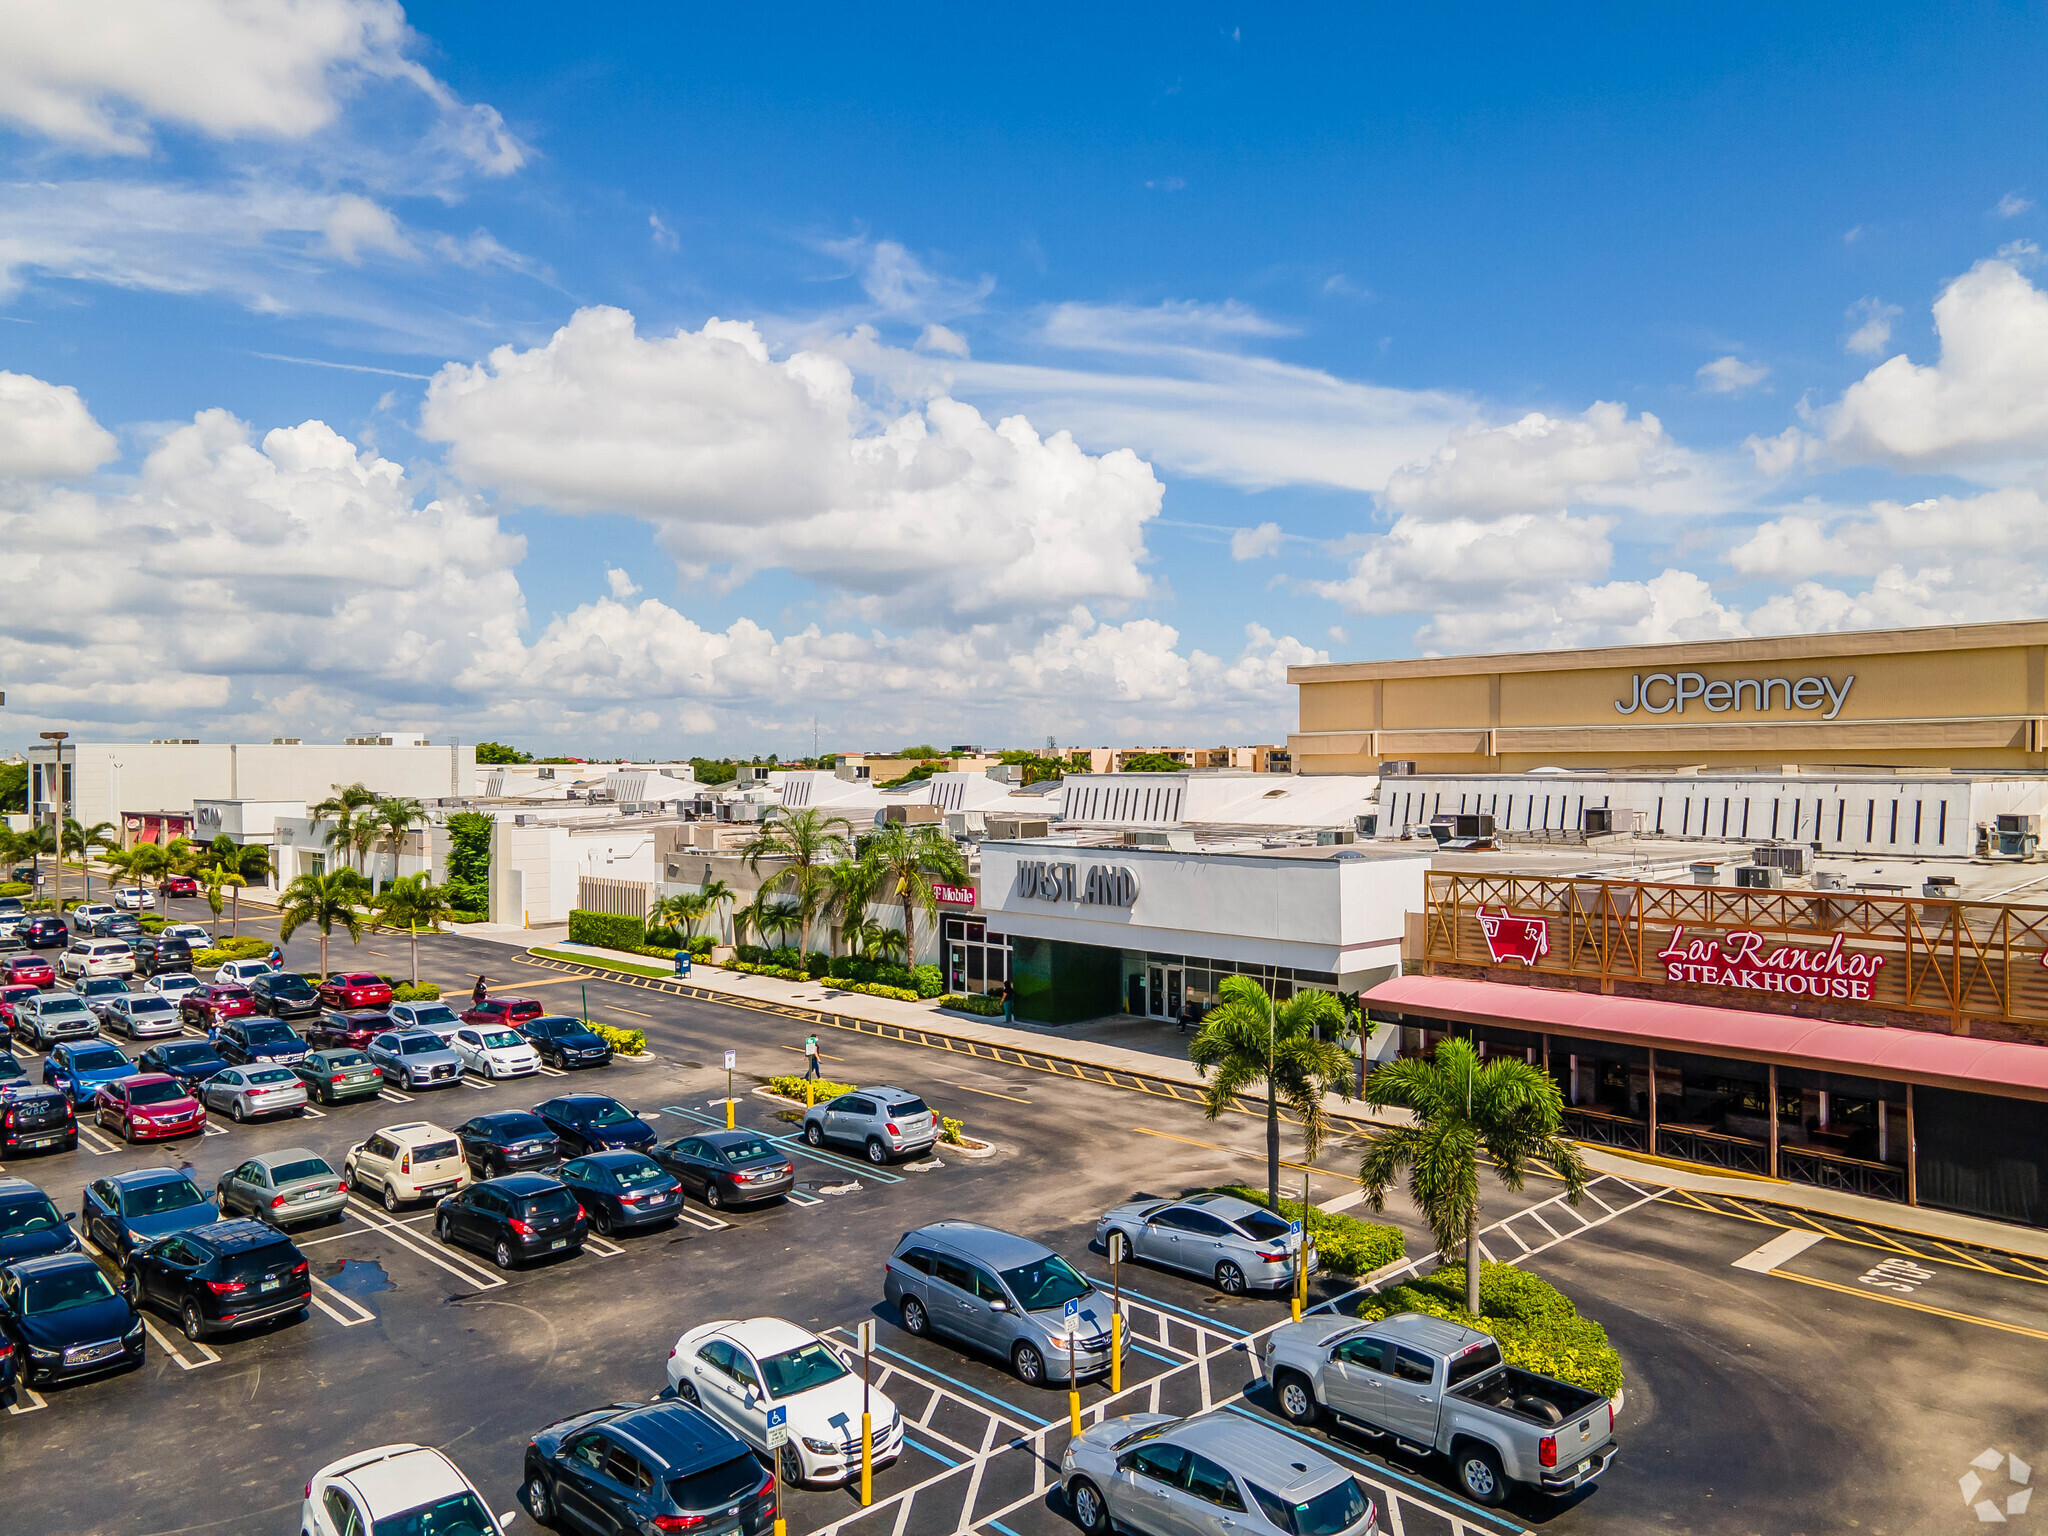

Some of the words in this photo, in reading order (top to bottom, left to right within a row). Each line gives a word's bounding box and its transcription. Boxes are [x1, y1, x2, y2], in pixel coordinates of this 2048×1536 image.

[1614, 671, 1855, 721] JCPenney
[942, 887, 973, 903] Mobile
[1016, 859, 1140, 907] WESTLAND
[1657, 924, 1720, 965] Los
[1721, 932, 1886, 980] Ranchos
[1667, 962, 1871, 1001] STEAKHOUSE
[1857, 1258, 1937, 1292] STOP
